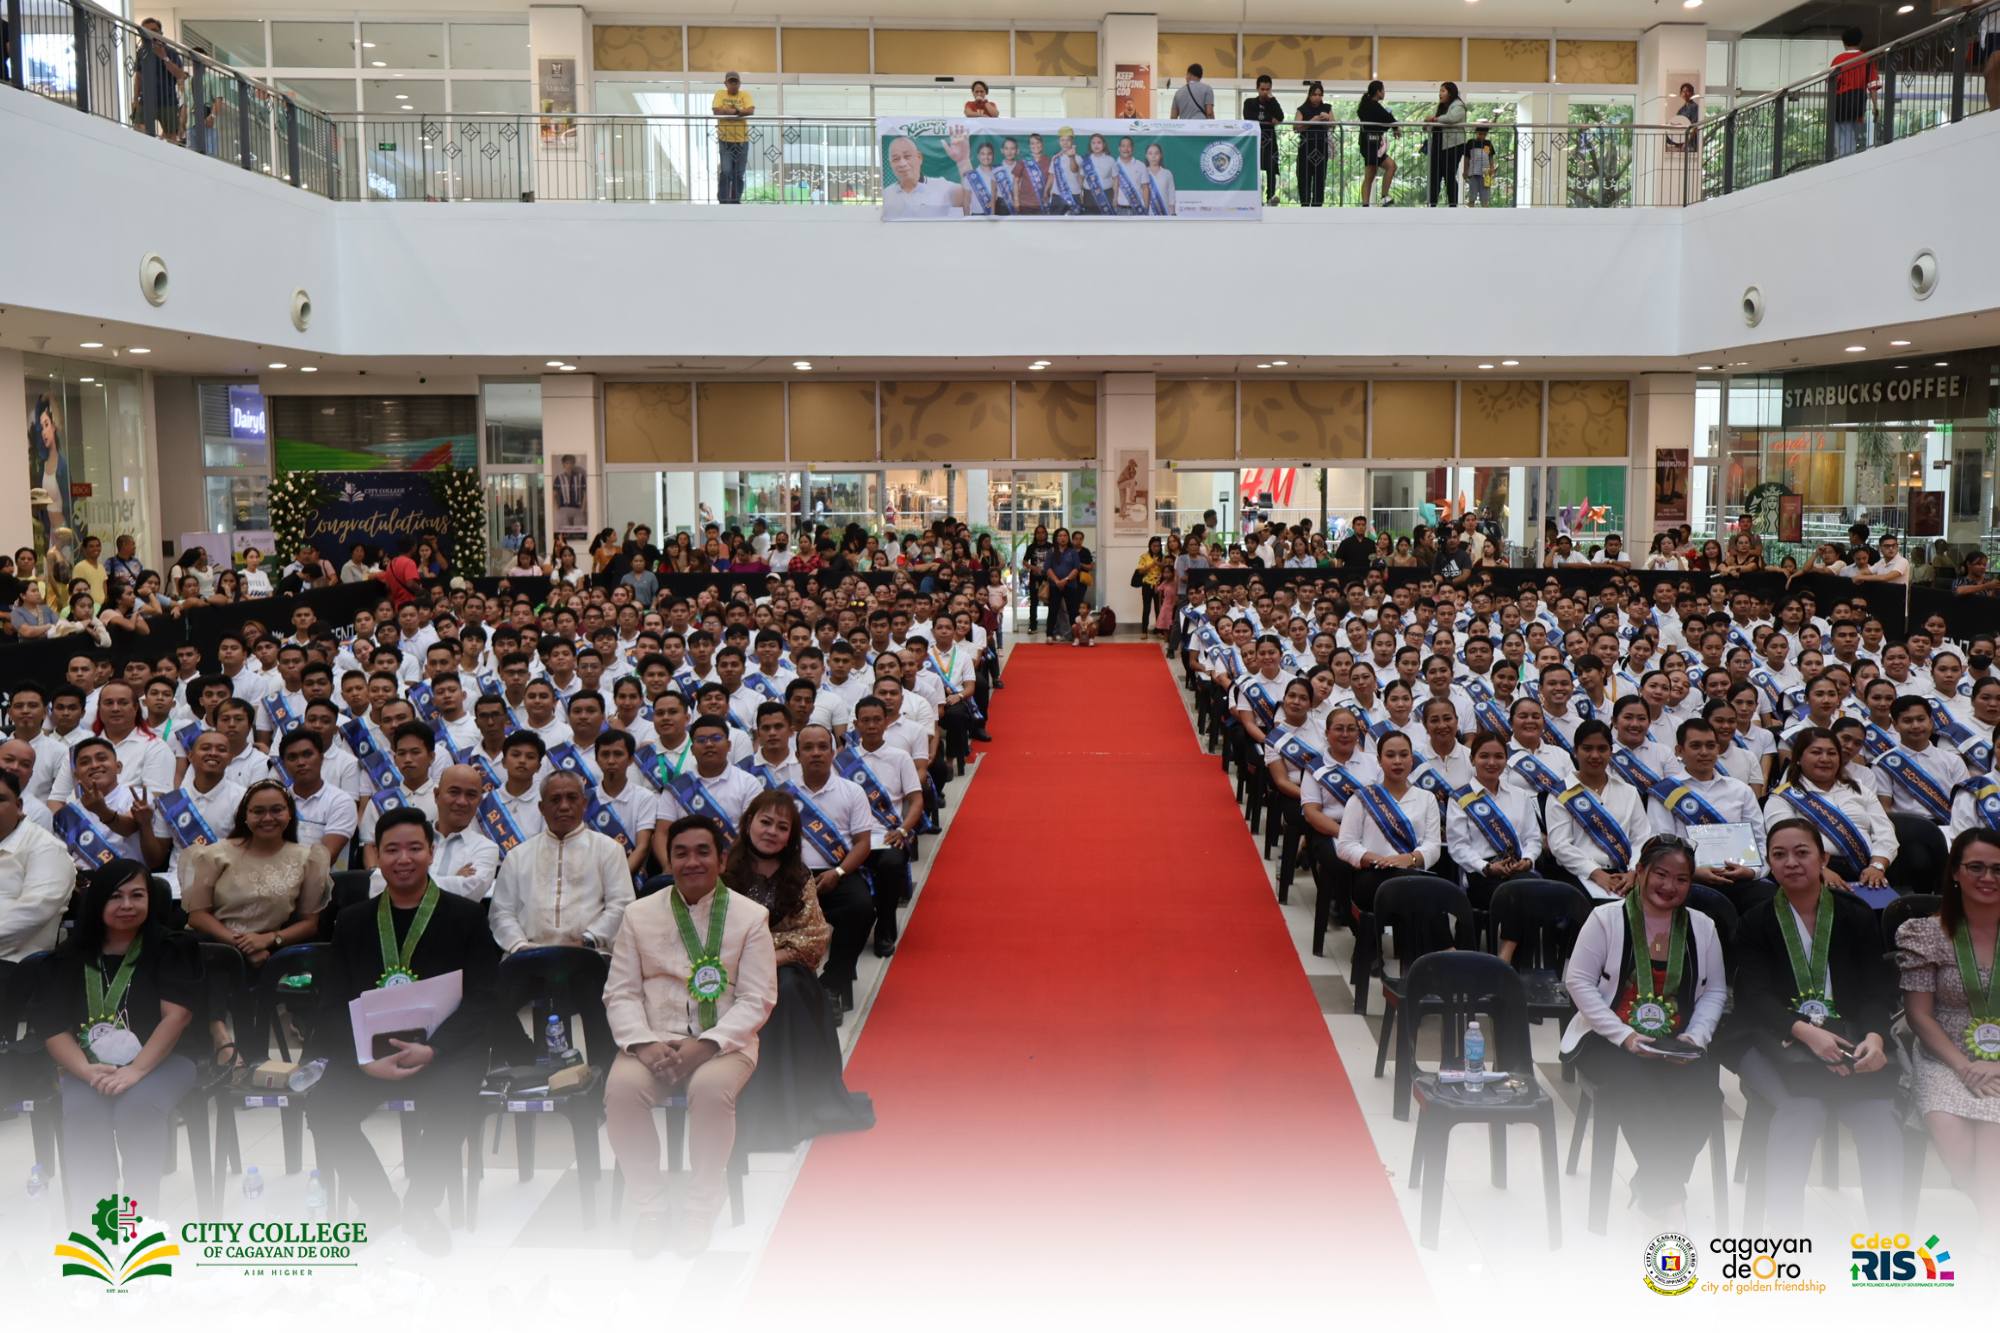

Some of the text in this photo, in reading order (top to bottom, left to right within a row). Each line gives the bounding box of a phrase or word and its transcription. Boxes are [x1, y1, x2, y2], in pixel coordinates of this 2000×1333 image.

[1785, 375, 1960, 408] STARBUCKS COFFEE
[303, 508, 450, 543] Congratulations
